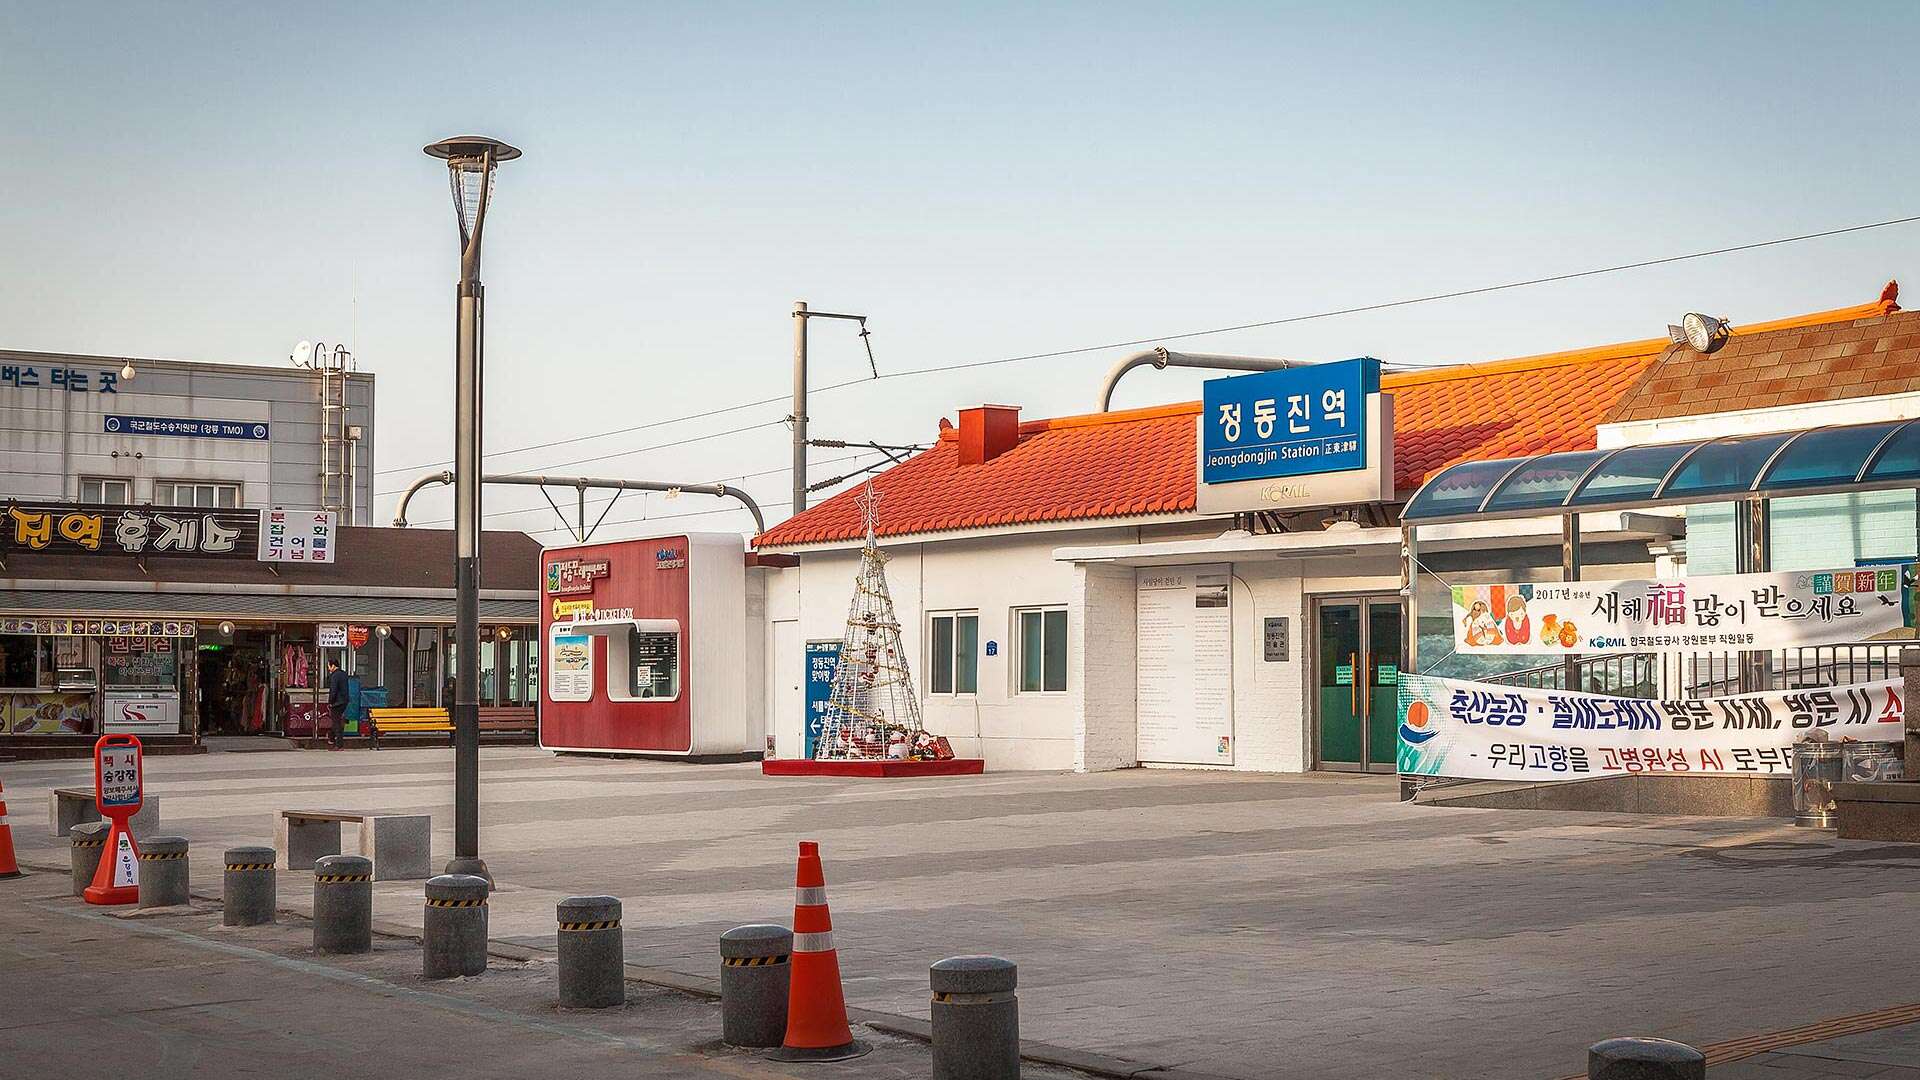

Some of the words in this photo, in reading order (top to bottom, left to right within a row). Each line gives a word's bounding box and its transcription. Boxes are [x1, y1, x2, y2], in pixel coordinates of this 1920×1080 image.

[2, 366, 39, 387] 버스
[51, 368, 88, 392] 타는
[99, 372, 117, 393] 곳
[1219, 389, 1345, 442] 정동진역
[130, 420, 198, 433] 국군철도수송지원반
[222, 427, 244, 435] TMO)
[1206, 450, 1277, 467] Jeongdongjin
[1281, 444, 1320, 460] Station
[0, 505, 104, 551] 진역
[115, 509, 242, 552] 휴게소
[1815, 570, 1896, 594] 謹賀新年
[1536, 588, 1570, 600] 2017년
[1591, 591, 1642, 624] 새해
[1646, 582, 1687, 626] 福
[1693, 594, 1746, 627] 많이
[1751, 585, 1862, 622] 받으세요
[109, 636, 173, 653] 편의점
[1589, 635, 1627, 648] KORAIL
[1630, 636, 1680, 646] 한국철도공사
[1682, 635, 1717, 645] 강원본부
[1719, 633, 1754, 644] 직원일동
[812, 657, 836, 669] 정동진역
[1450, 689, 1529, 727] 축산농장
[1548, 696, 1661, 730] 철새도래지
[1661, 699, 1714, 730] 방문
[1714, 698, 1782, 730] 자제,
[1782, 690, 1839, 728] 방문
[1845, 687, 1872, 724] 시
[1878, 686, 1904, 723] 소
[1487, 743, 1590, 772] 우리고향을
[1598, 747, 1690, 772] 고병원성
[1700, 748, 1724, 770] AI
[104, 770, 136, 782] 승강장
